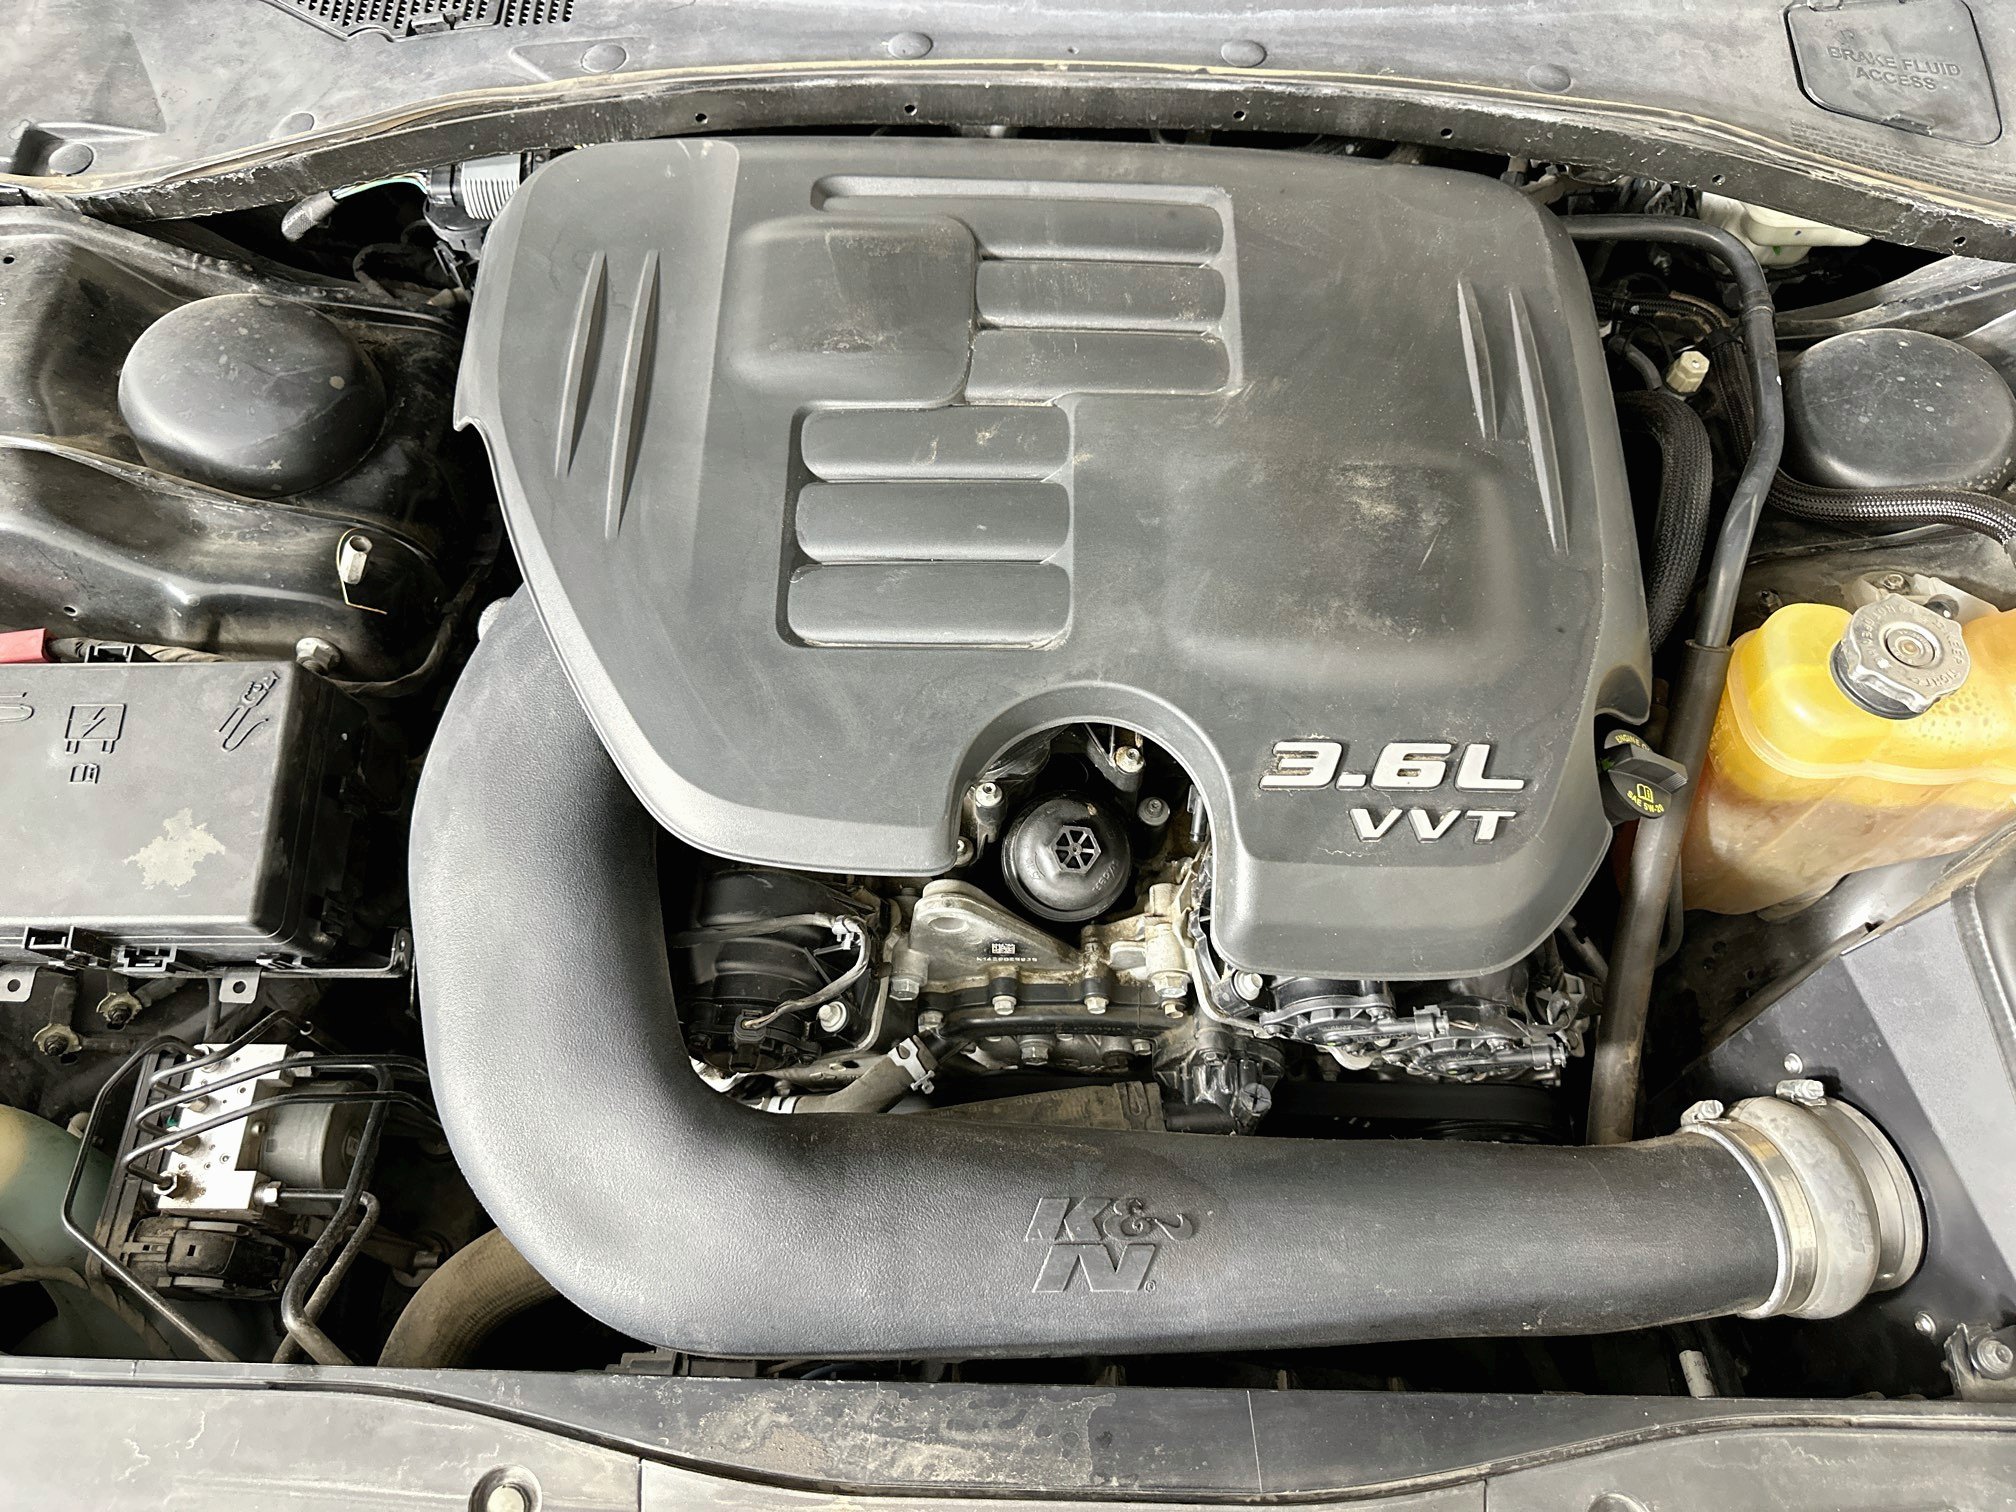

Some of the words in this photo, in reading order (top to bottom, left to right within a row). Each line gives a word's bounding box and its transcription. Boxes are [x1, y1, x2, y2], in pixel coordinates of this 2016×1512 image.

[1827, 46, 1897, 69] BRAKE
[1901, 59, 1961, 77] FLUID
[1856, 66, 1937, 90] ACCESS
[1614, 734, 1641, 747] ENGINE
[1258, 741, 1526, 792] 3.6L
[1626, 790, 1643, 807] SAE
[1643, 802, 1665, 814] 5W-20
[1349, 808, 1517, 844] VVT
